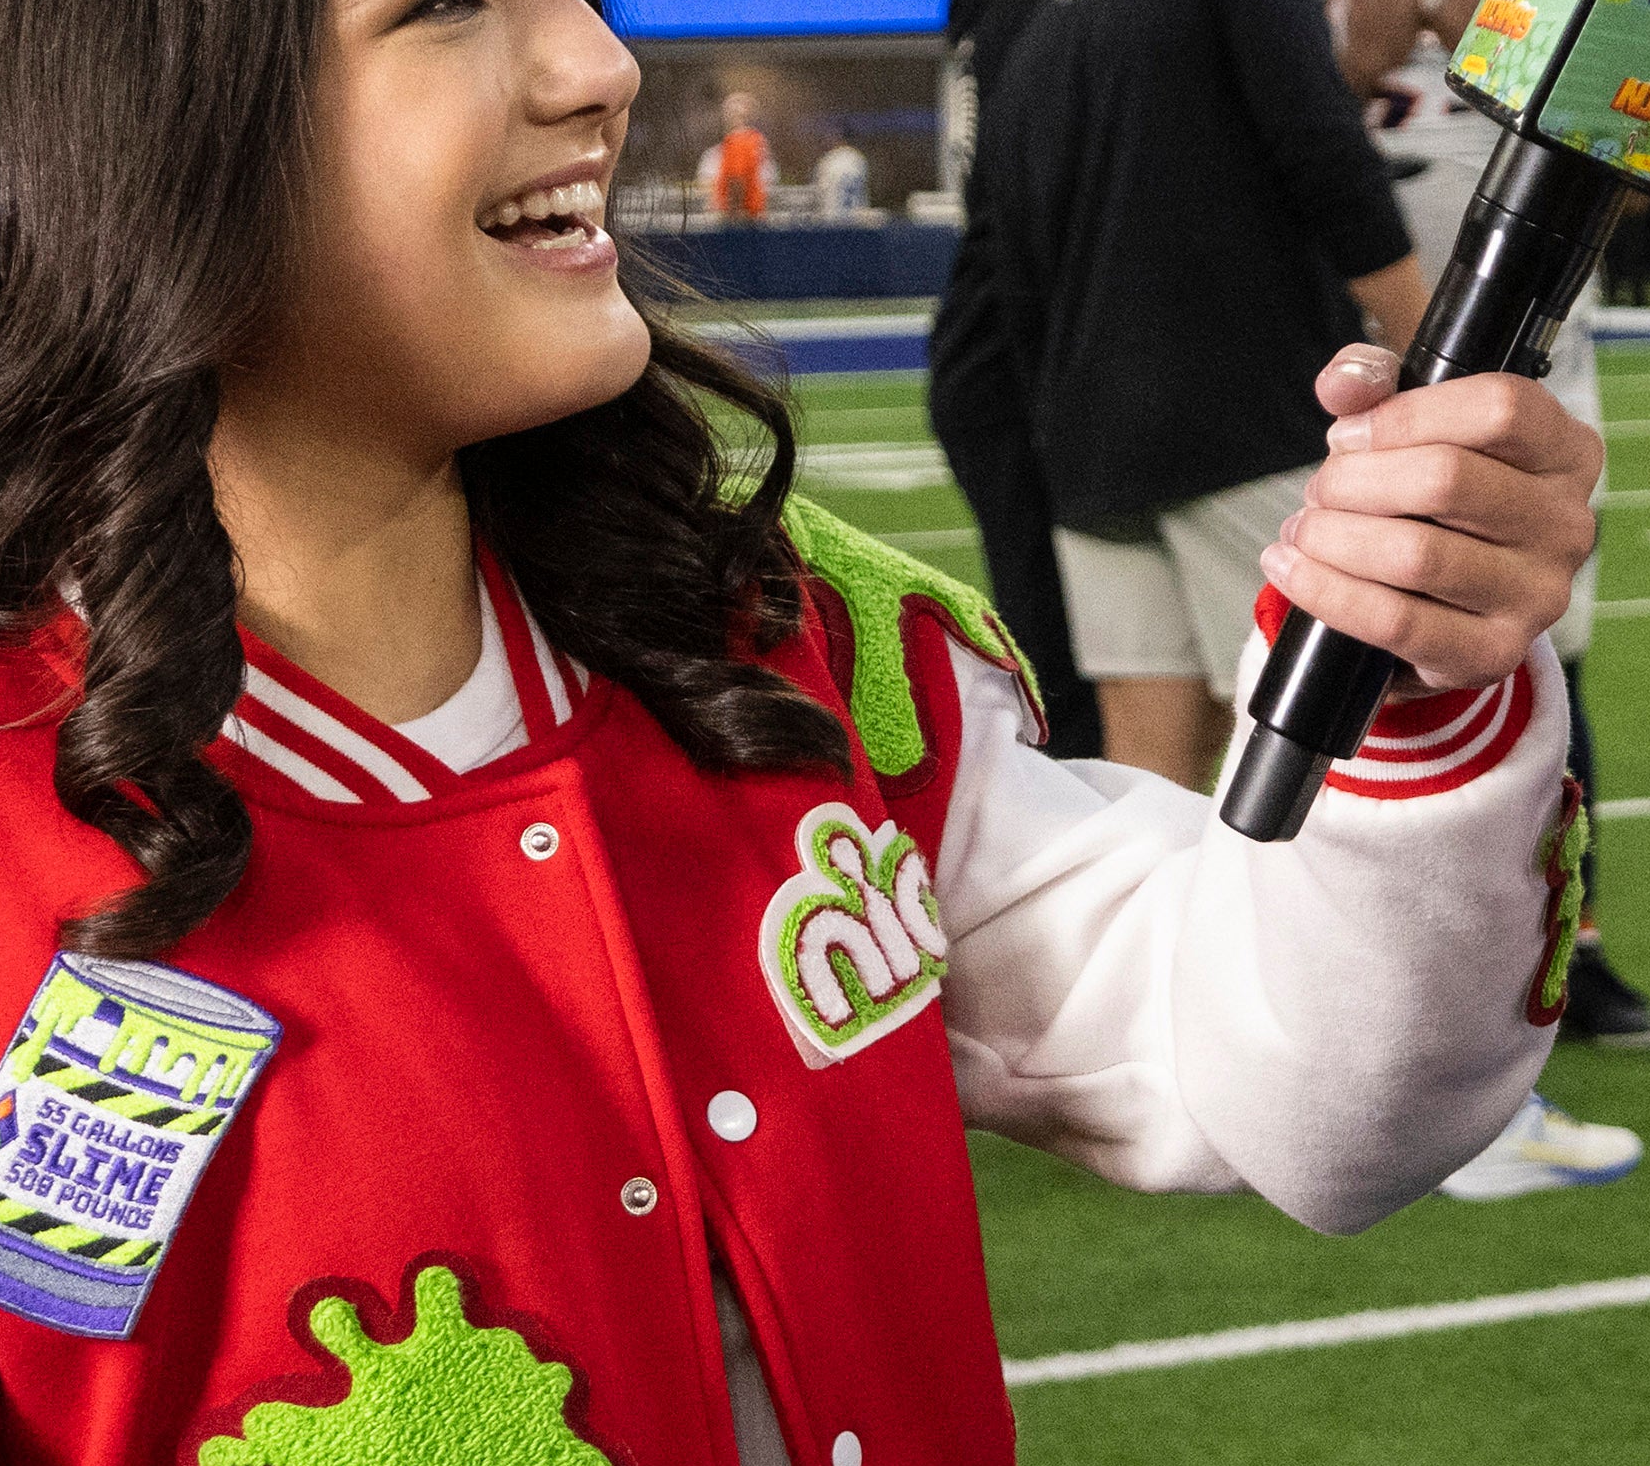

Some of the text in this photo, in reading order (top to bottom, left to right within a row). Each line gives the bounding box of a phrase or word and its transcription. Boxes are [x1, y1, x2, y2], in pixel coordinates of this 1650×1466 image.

[788, 829, 948, 1035] nic
[17, 1122, 174, 1207] SLIME
[36, 1097, 185, 1164] 55 GALLONS
[56, 1183, 155, 1230] POUNDS
